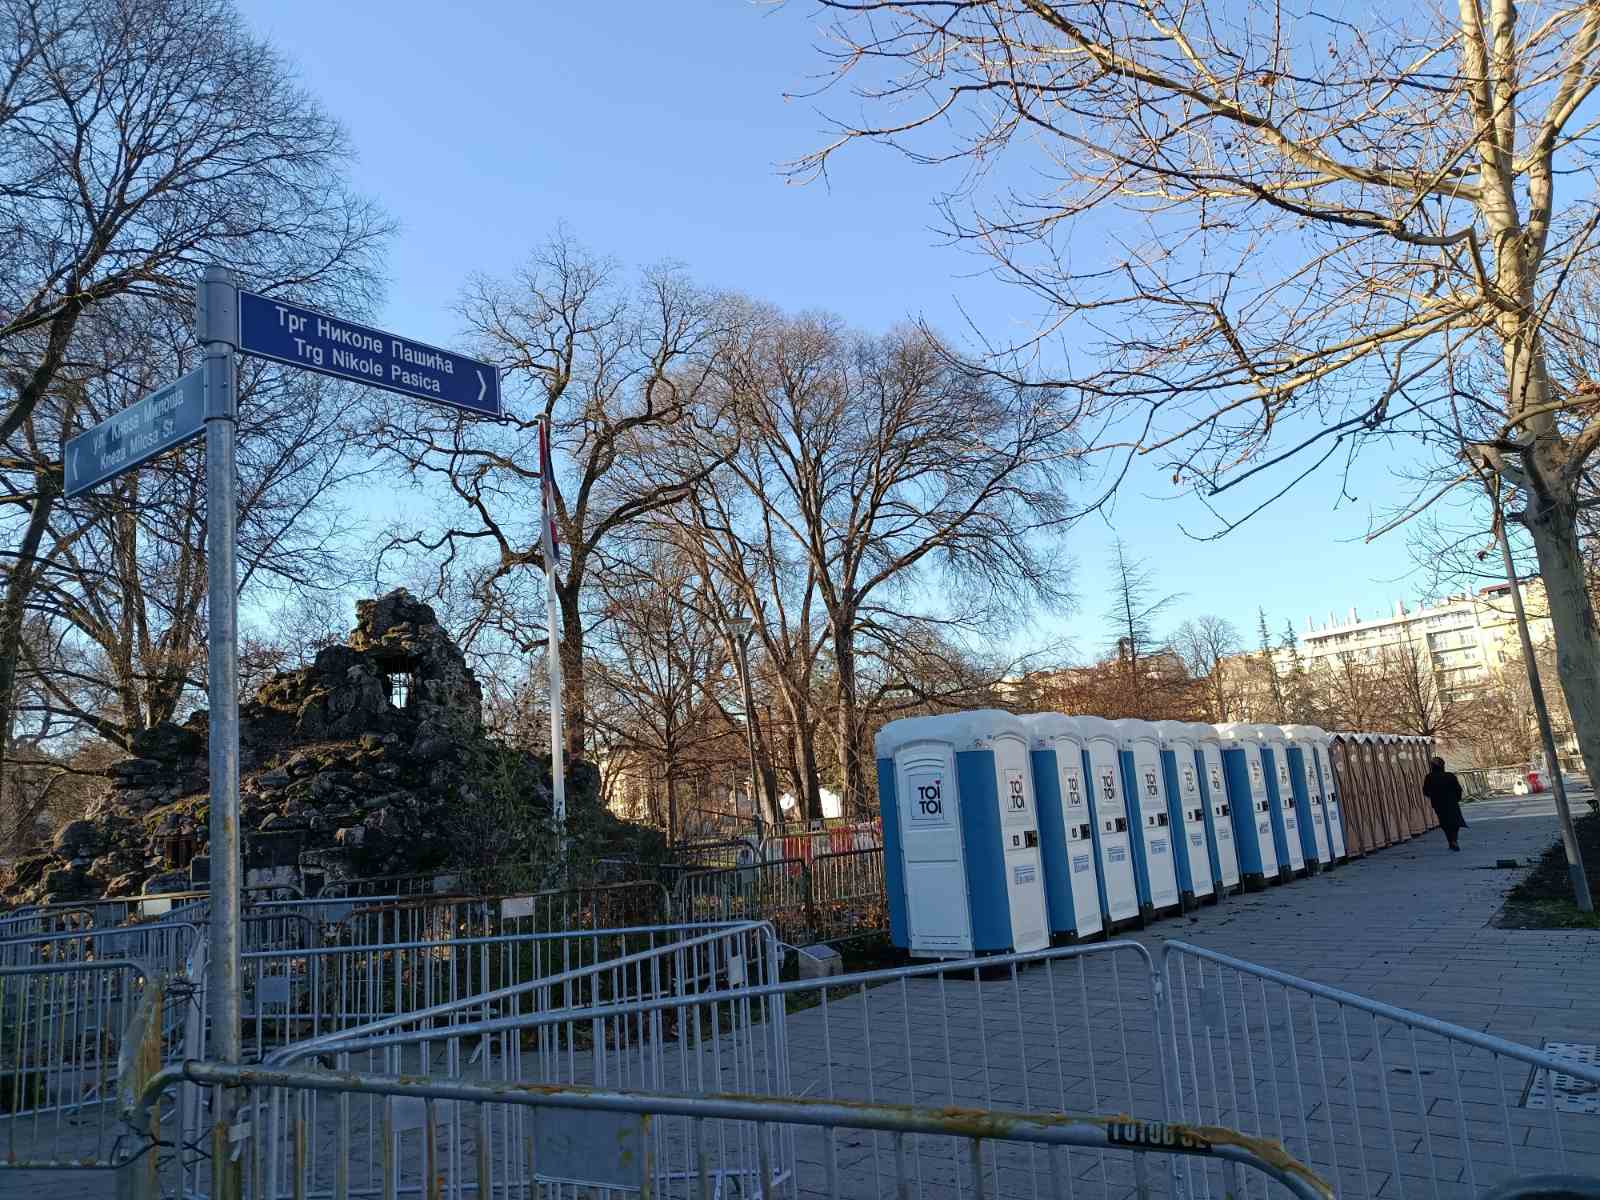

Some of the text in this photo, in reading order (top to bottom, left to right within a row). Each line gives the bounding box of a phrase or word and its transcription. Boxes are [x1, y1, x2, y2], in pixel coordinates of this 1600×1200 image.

[275, 306, 454, 375] Трг Николе Пашића
[294, 338, 441, 393] Trg Nikole Pasica
[918, 800, 942, 814] TOI
